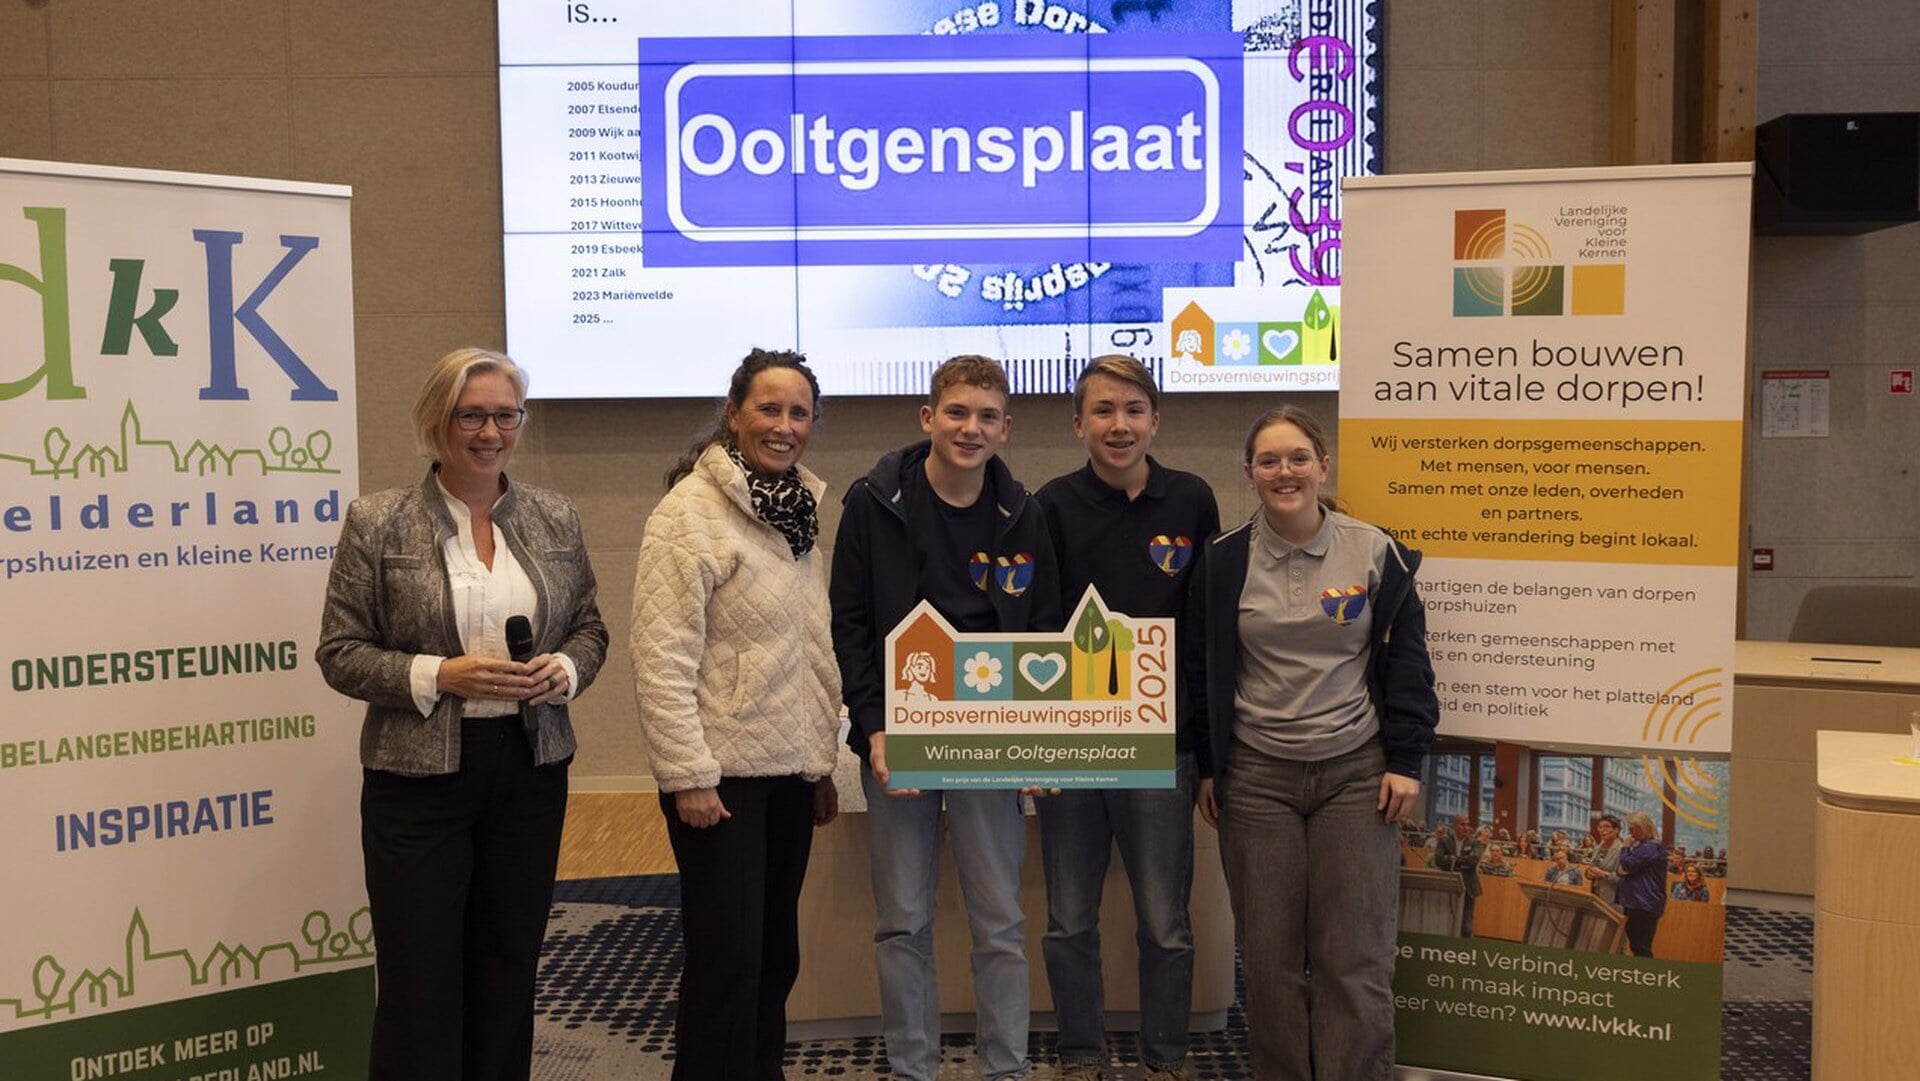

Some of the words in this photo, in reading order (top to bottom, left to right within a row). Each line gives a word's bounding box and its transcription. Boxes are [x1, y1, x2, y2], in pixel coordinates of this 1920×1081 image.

[567, 81, 595, 92] 2005
[567, 104, 595, 115] 2007
[598, 103, 640, 114] Elsend
[568, 128, 596, 138] 2009
[598, 126, 624, 139] Wijk
[569, 151, 596, 161] 2011
[680, 110, 1202, 190] Ooltgensplaat
[569, 174, 597, 185] 2013
[570, 197, 598, 208] 2015
[1560, 205, 1628, 218] Landelijke
[570, 221, 598, 231] 2017
[1554, 217, 1627, 229] Vereniging
[1598, 228, 1627, 236] voor
[571, 244, 599, 254] 2019
[1585, 237, 1627, 247] Kleine
[1579, 248, 1626, 259] Kernen
[571, 267, 598, 278] 2021
[601, 267, 626, 277] Zalk
[572, 290, 600, 301] 2023
[602, 289, 674, 300] Mariënvelde
[573, 313, 601, 324] 2025
[1393, 341, 1517, 368] Samen
[1532, 339, 1684, 367] bouwen
[1374, 379, 1437, 402] aan
[1448, 373, 1545, 402] vitale
[1556, 373, 1703, 408] dorpen!
[1371, 436, 1398, 452] Wij
[1401, 437, 1488, 451] versterken
[1493, 437, 1706, 454] dorpsgemeenschappen.
[1421, 459, 1452, 473] Met
[1457, 462, 1529, 475] mensen,
[1533, 463, 1570, 474] voor
[1576, 463, 1650, 475] mensen.
[1388, 482, 1446, 495] Samen
[1450, 483, 1484, 496] met
[1488, 486, 1529, 497] onze
[1533, 483, 1585, 499] leden,
[1590, 485, 1684, 499] overheden
[3, 489, 340, 532] elderland
[1481, 508, 1502, 519] en
[1507, 507, 1583, 523] partners.
[1387, 528, 1417, 540] ant
[1421, 528, 1468, 541] echte
[1472, 530, 1574, 548] verandering
[1579, 532, 1637, 550] begint
[1641, 533, 1698, 548] lokaal.
[137, 553, 168, 568] en
[177, 544, 252, 566] kleine
[1487, 582, 1508, 595] de
[1513, 583, 1592, 600] belangen
[1597, 588, 1628, 599] van
[1633, 587, 1696, 603] dorpen
[1481, 634, 1634, 653] gemeenschappen
[1640, 640, 1676, 653] met
[11, 640, 297, 692] ONDERSTEUNING
[1448, 651, 1468, 662] en
[1472, 650, 1595, 671] ondersteuning
[1137, 624, 1168, 724] 2025
[1451, 682, 1482, 694] een
[1485, 684, 1527, 697] stem
[1531, 688, 1568, 699] voor
[1573, 687, 1601, 701] het
[1606, 688, 1694, 706] platteland
[894, 707, 1132, 728] Dorpsvernieuwingsprijs
[1462, 701, 1483, 713] en
[1487, 700, 1549, 718] politiek
[1, 714, 316, 769] BELANGENBEHARTIGING
[924, 745, 1001, 761] Winnaar
[1006, 744, 1137, 763] Ooltgensplaat
[55, 789, 274, 852] INSPIRATIE
[1420, 947, 1477, 966] mee!
[1483, 950, 1579, 980] Verbind,
[1585, 963, 1682, 989] versterk
[1427, 973, 1454, 989] en
[1462, 975, 1526, 998] maak
[1532, 980, 1615, 1009] impact
[1435, 998, 1517, 1022] weten?
[1523, 1008, 1672, 1041] www.lvkk.nl
[70, 1043, 166, 1081] ONTDEK
[174, 1029, 239, 1062] MEER
[246, 1022, 275, 1047] OP
